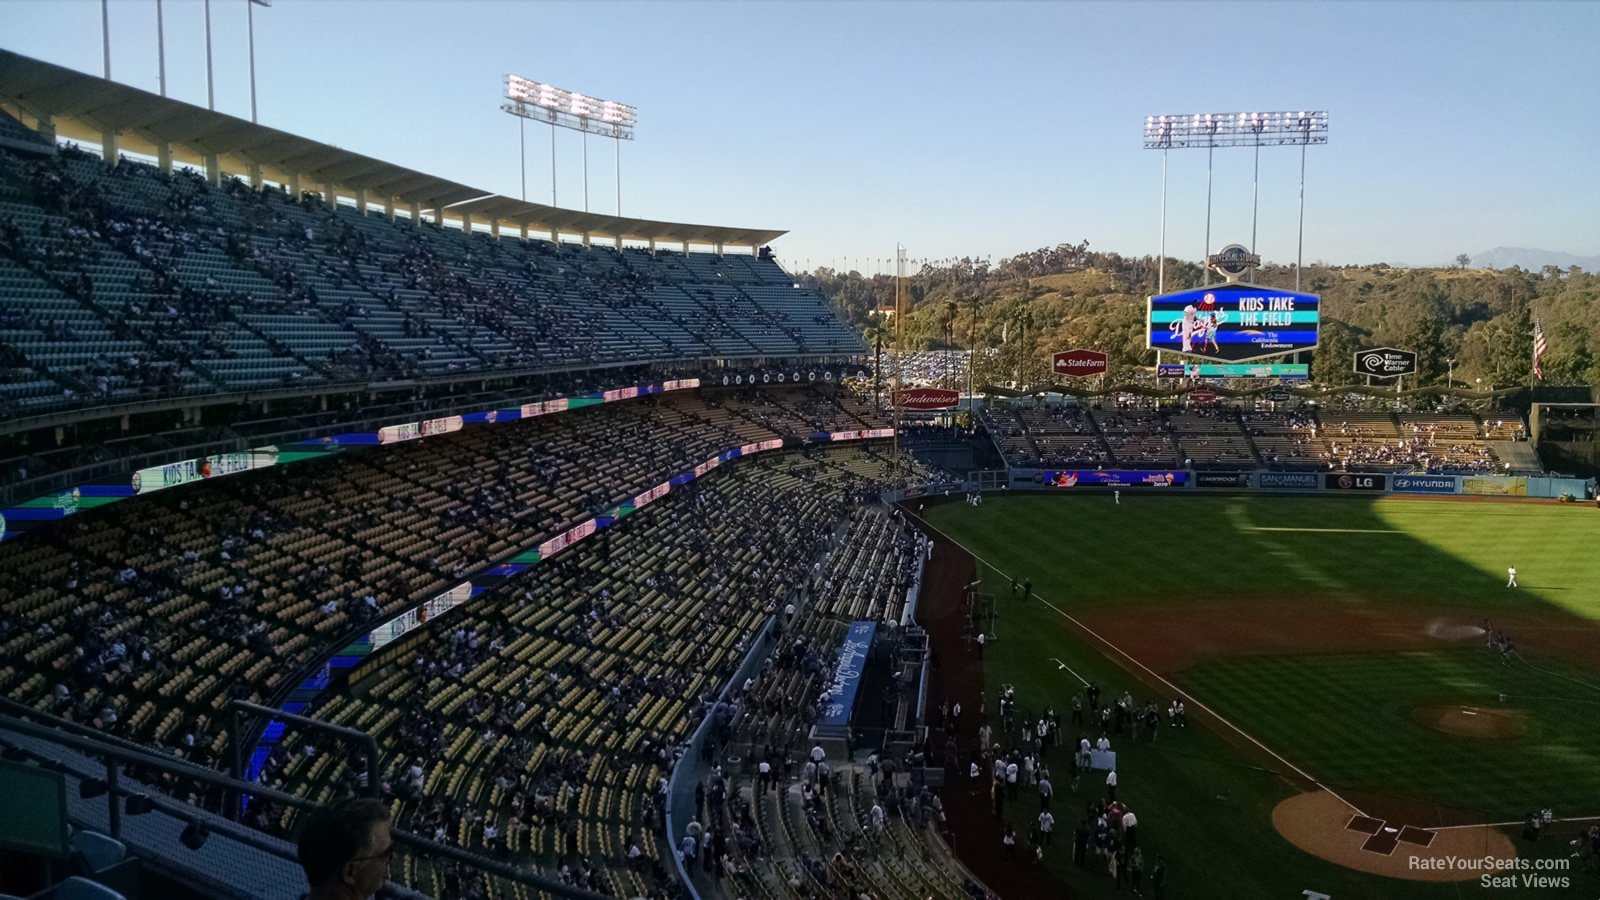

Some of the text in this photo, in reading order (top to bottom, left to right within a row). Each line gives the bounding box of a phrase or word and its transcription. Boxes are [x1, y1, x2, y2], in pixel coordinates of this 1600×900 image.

[1239, 297, 1295, 311] KIDS TAKE
[1240, 312, 1292, 326] THE FIELD
[900, 392, 958, 404] Budweiser
[162, 464, 182, 486] KIDS
[227, 453, 248, 472] FIELD
[1356, 478, 1373, 487] LG
